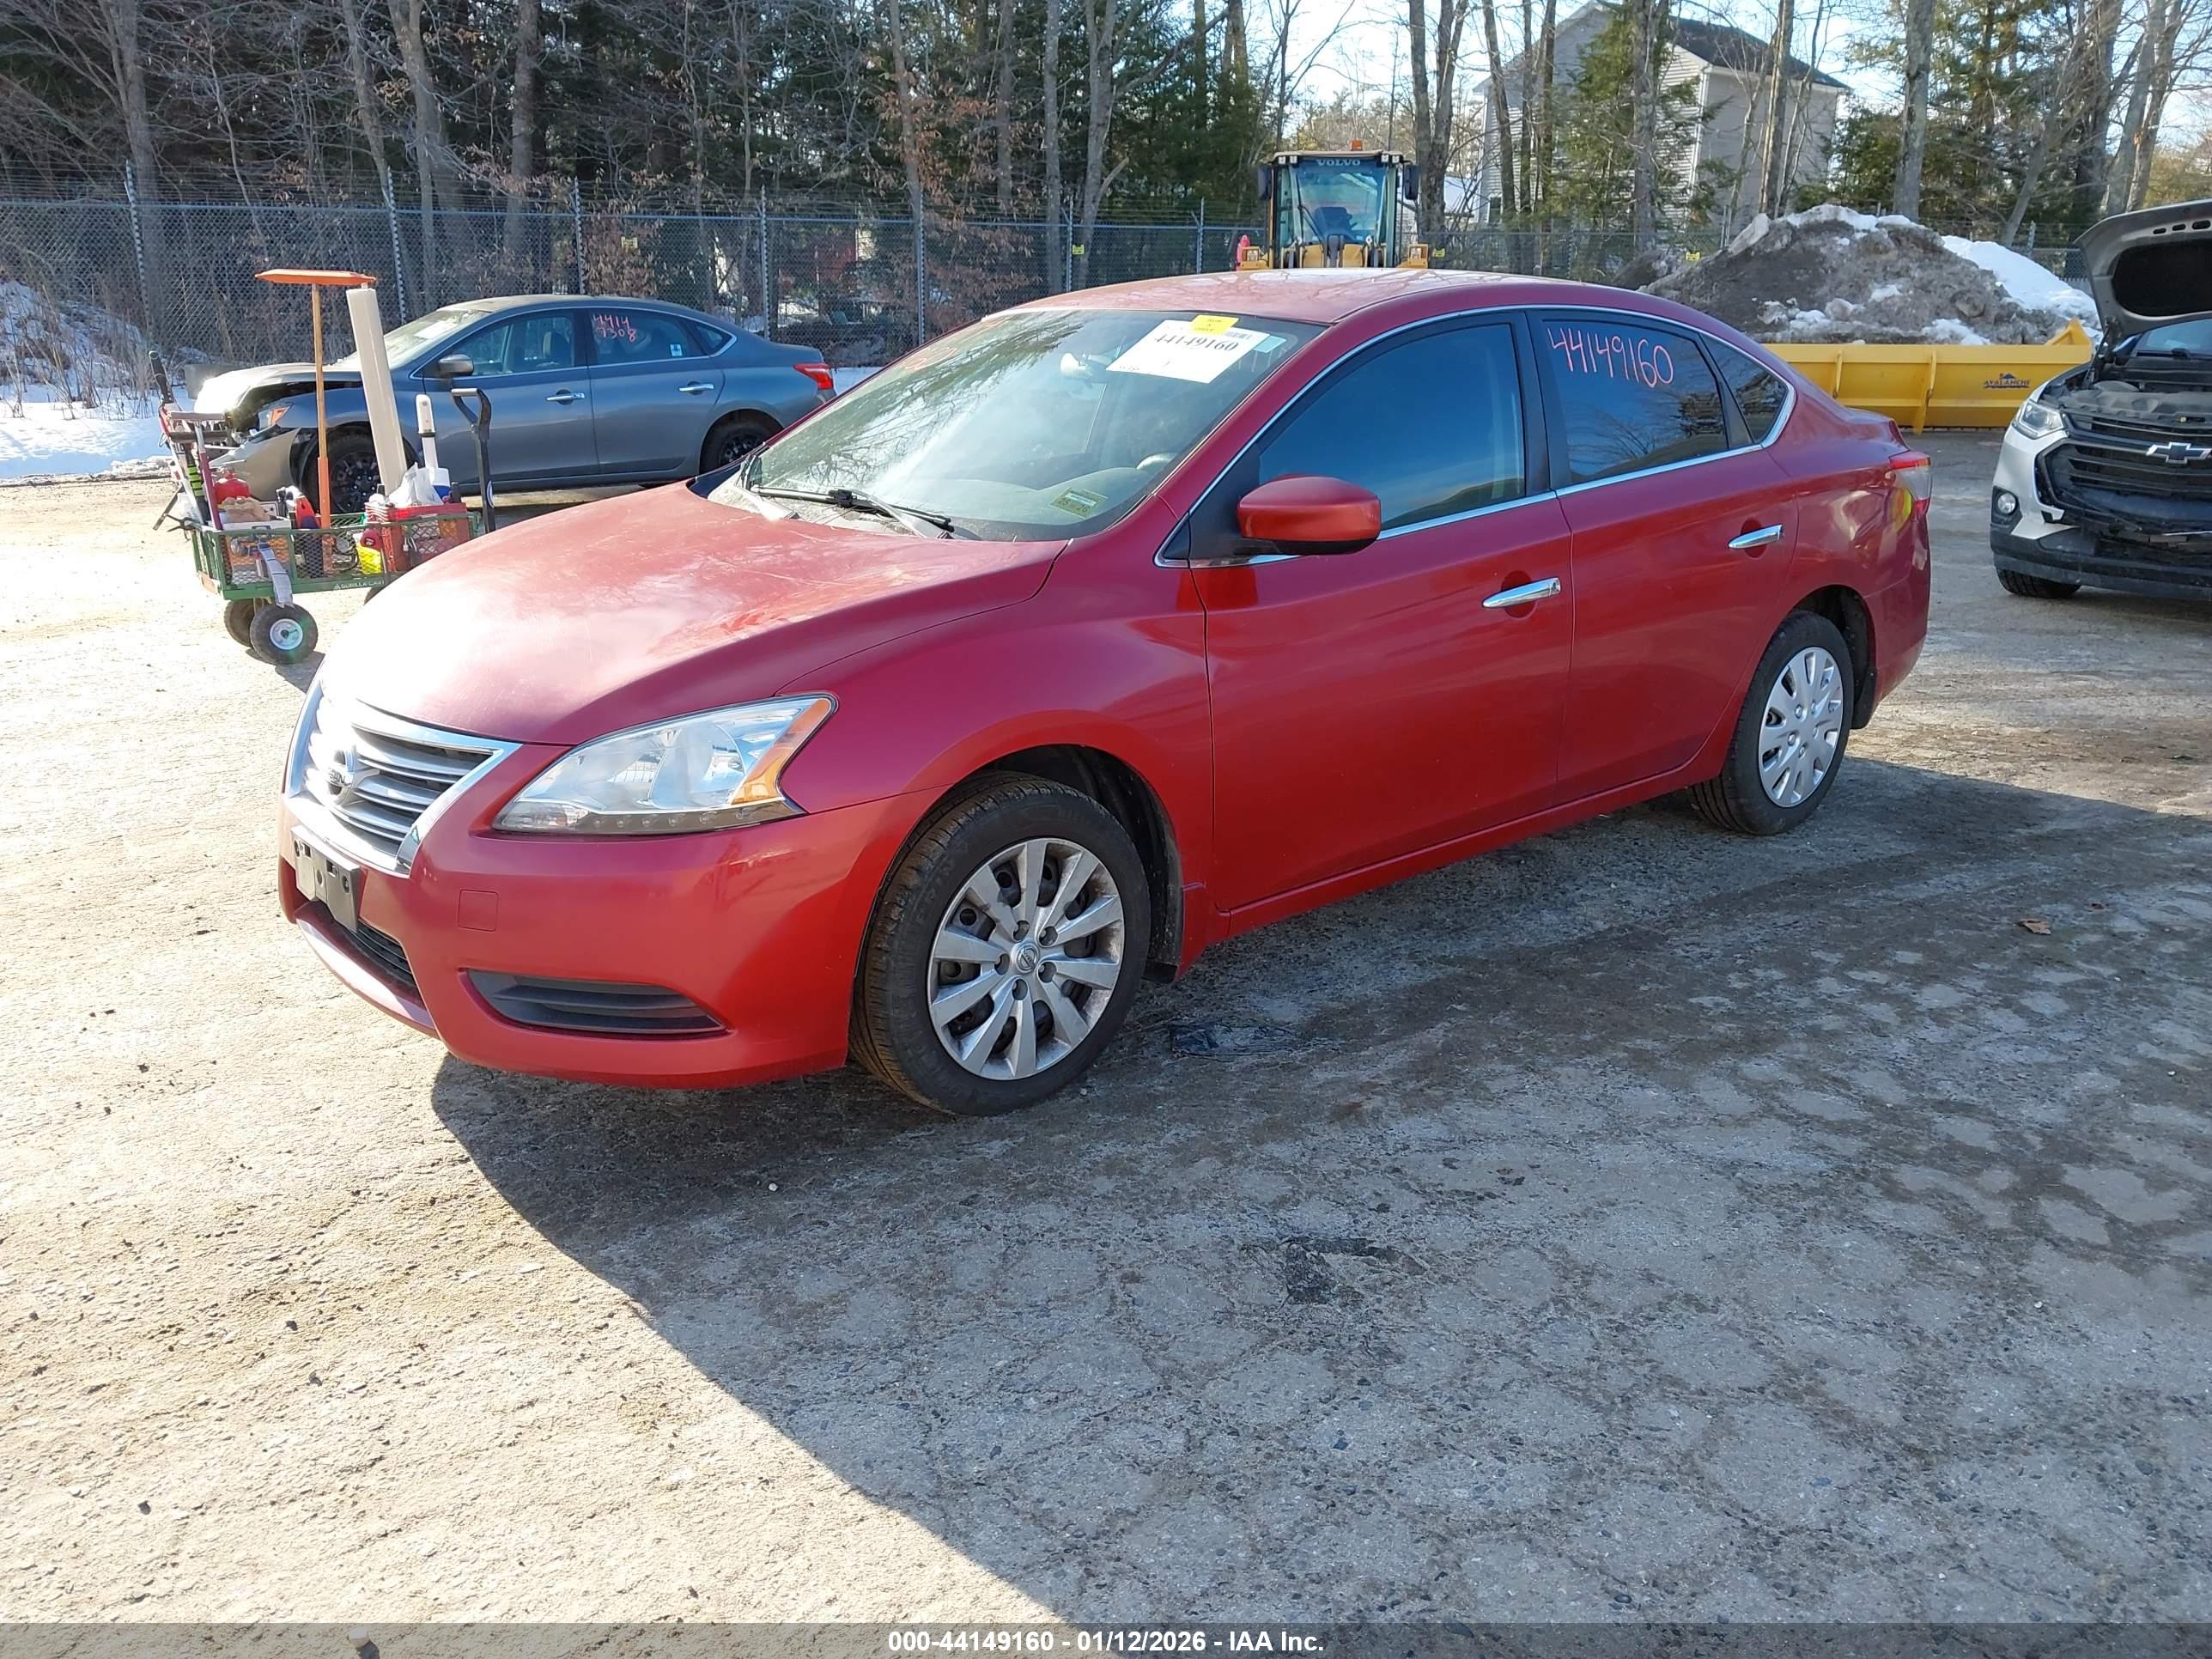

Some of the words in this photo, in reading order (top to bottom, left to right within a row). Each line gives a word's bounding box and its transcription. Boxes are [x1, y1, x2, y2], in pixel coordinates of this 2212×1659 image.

[1316, 158, 1361, 167] VOLVO
[592, 313, 631, 330] 4414
[1153, 333, 1239, 351] 44149160
[1546, 327, 1674, 388] 44149160
